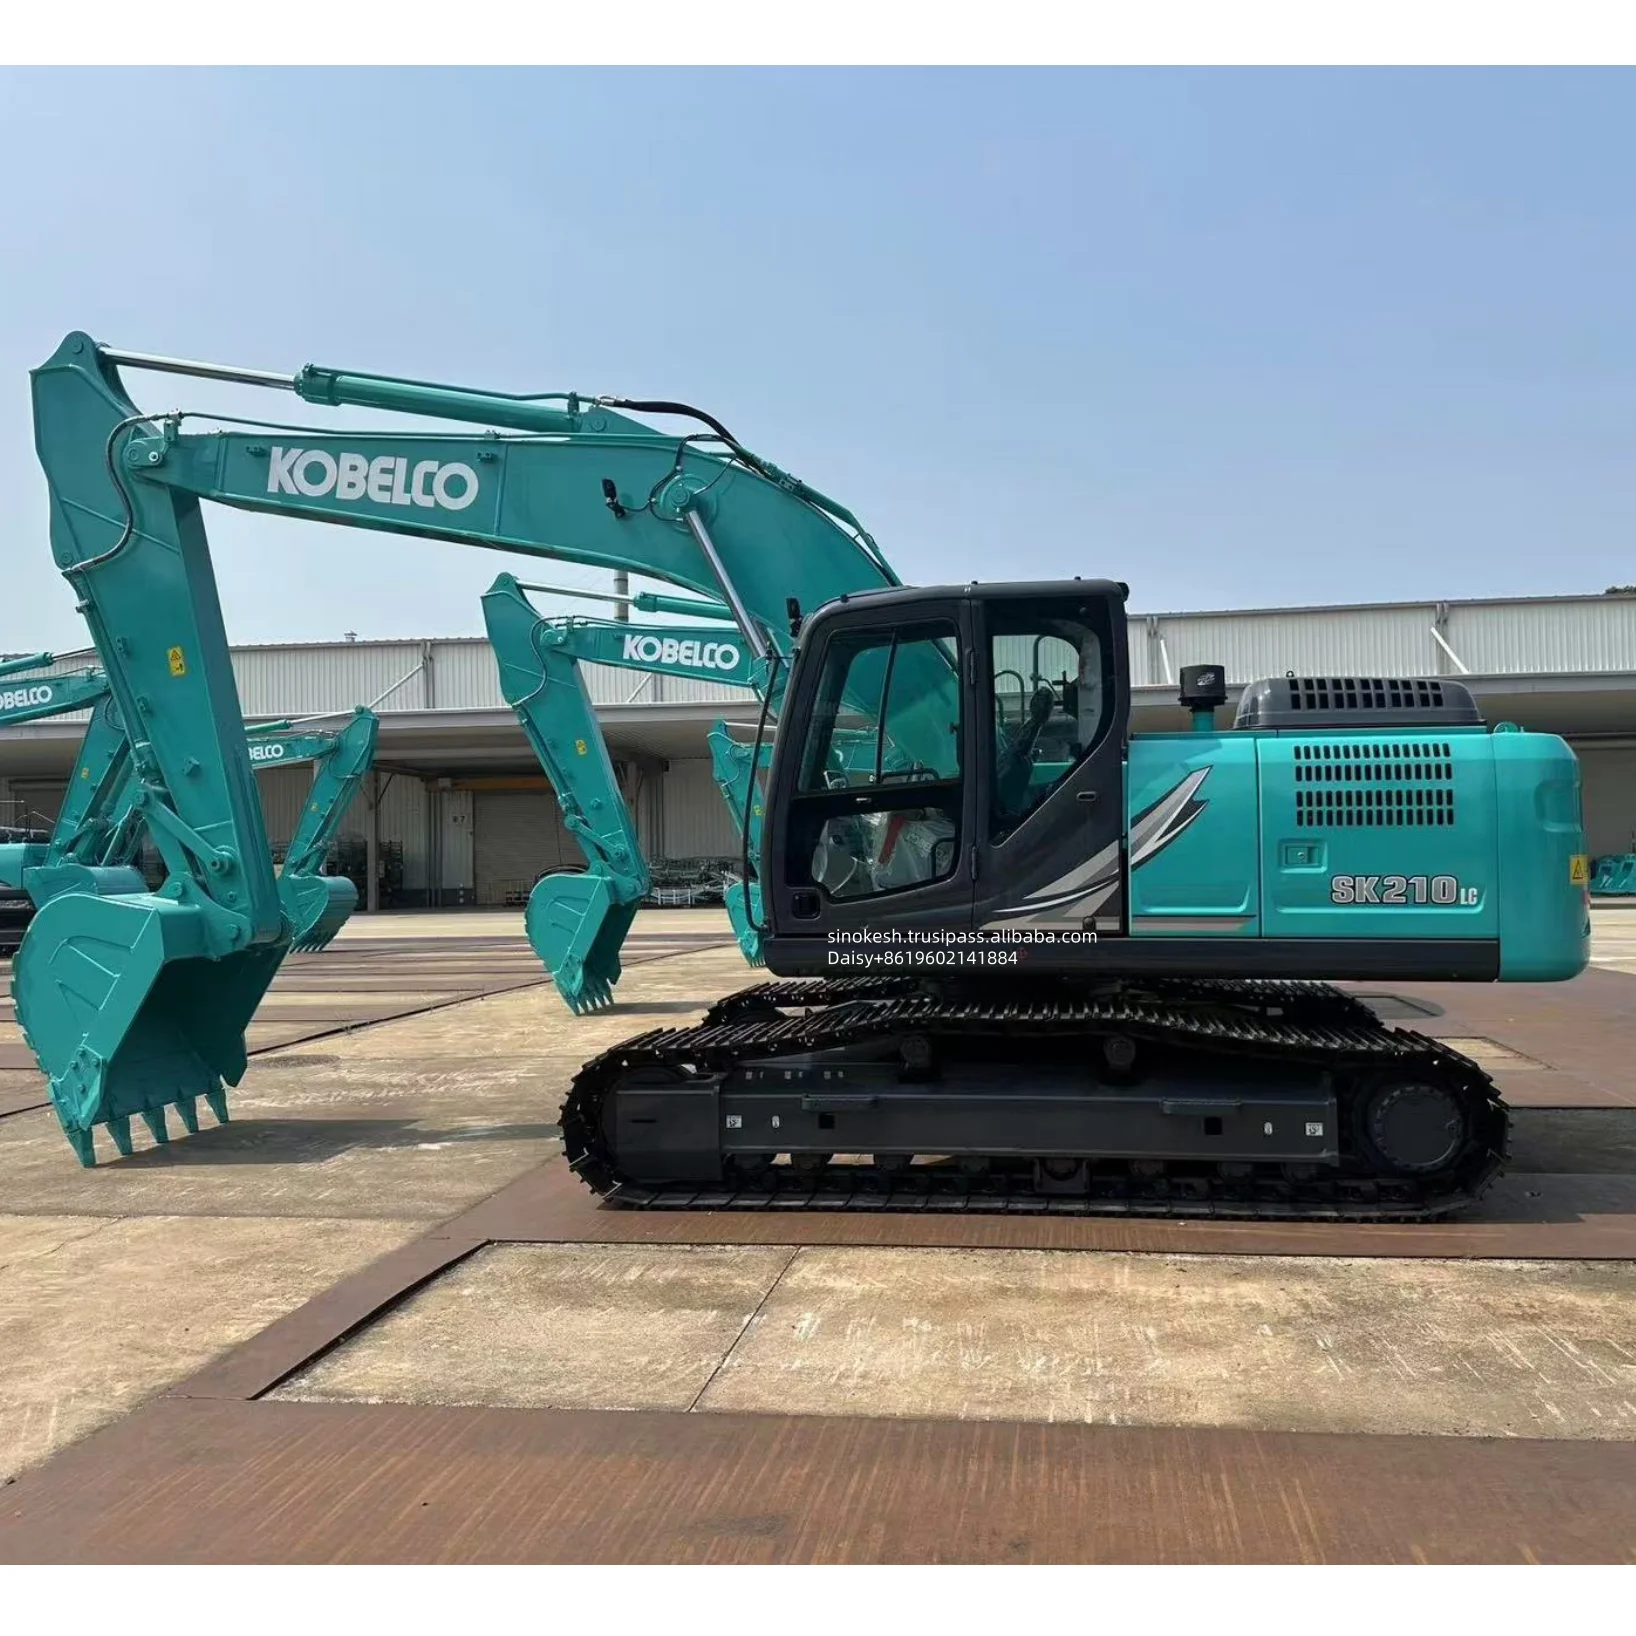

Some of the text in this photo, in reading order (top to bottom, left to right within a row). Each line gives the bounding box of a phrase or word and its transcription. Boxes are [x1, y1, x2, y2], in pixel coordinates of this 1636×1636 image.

[267, 446, 479, 511] KOBELCO
[623, 634, 740, 670] KOBELCO
[0, 685, 52, 710] BELCO
[1331, 874, 1478, 905] SK210 LC
